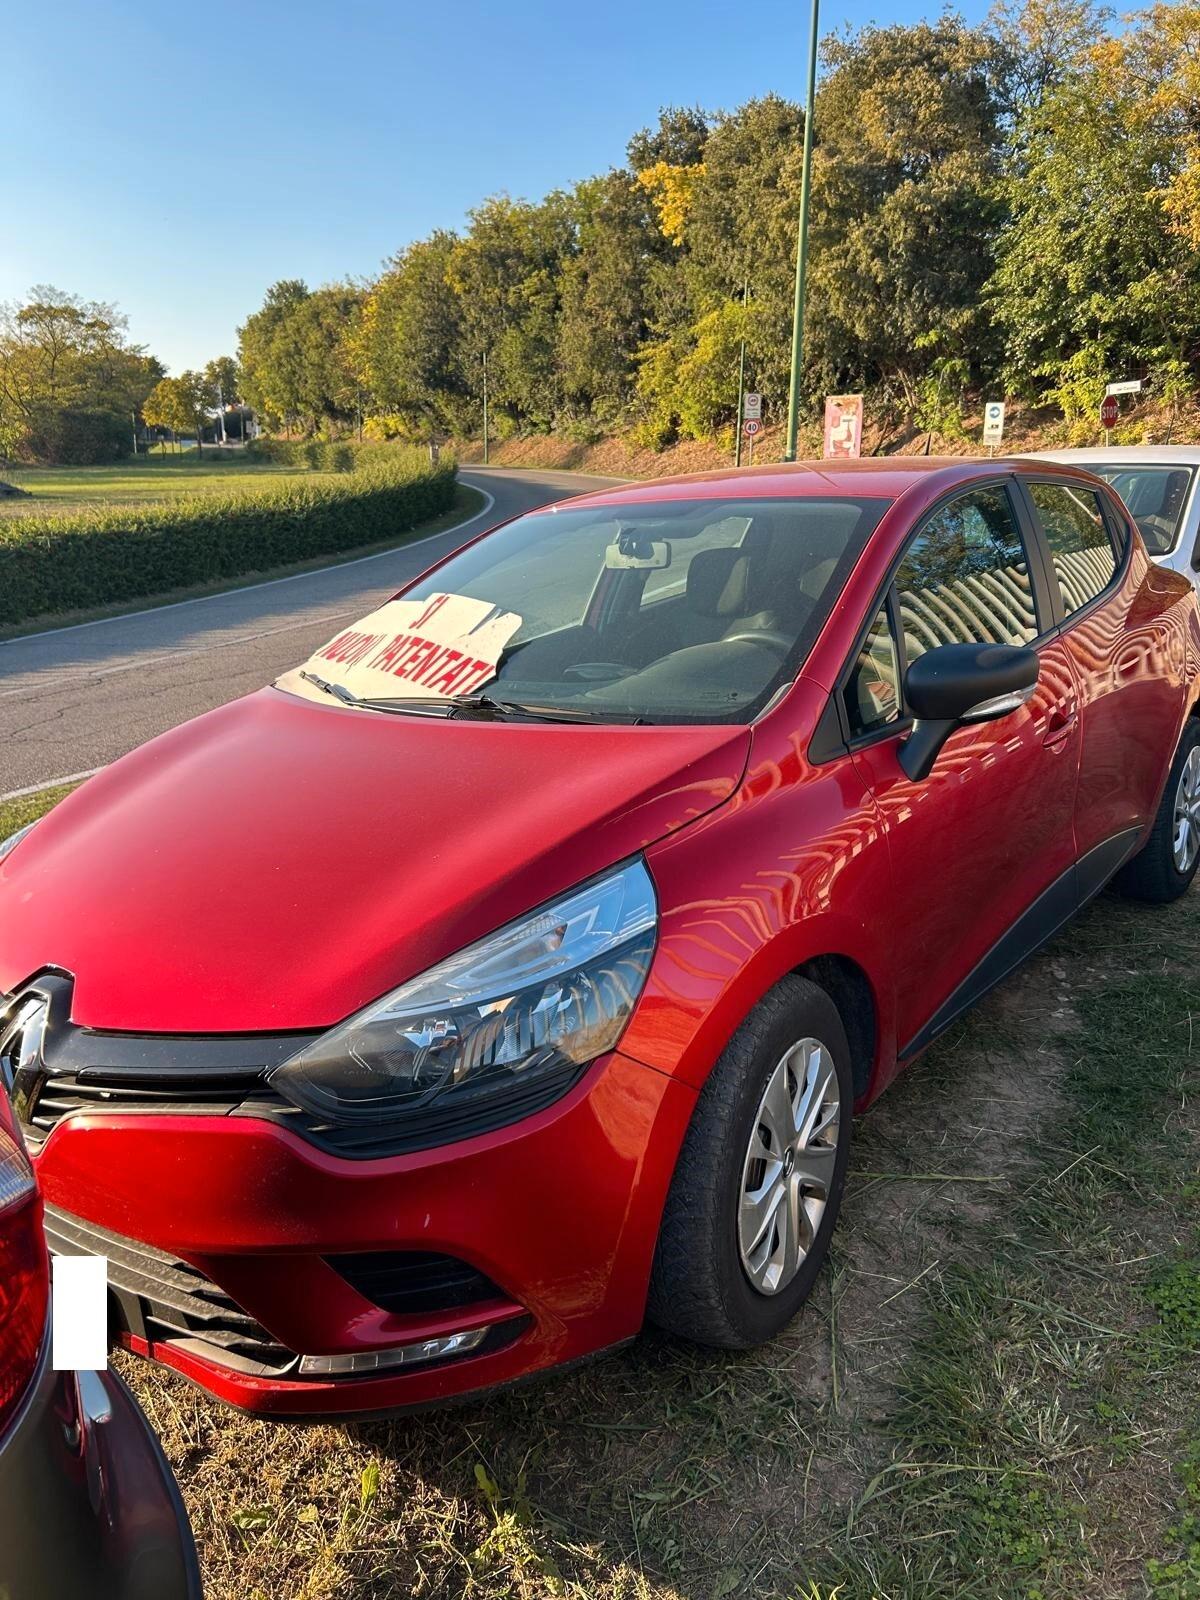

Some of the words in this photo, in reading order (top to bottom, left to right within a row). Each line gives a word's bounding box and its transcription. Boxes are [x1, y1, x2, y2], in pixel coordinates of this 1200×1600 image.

[1102, 406, 1117, 419] STOP
[747, 423, 756, 431] 40
[408, 595, 450, 629] SI
[366, 634, 496, 695] PATENTATI
